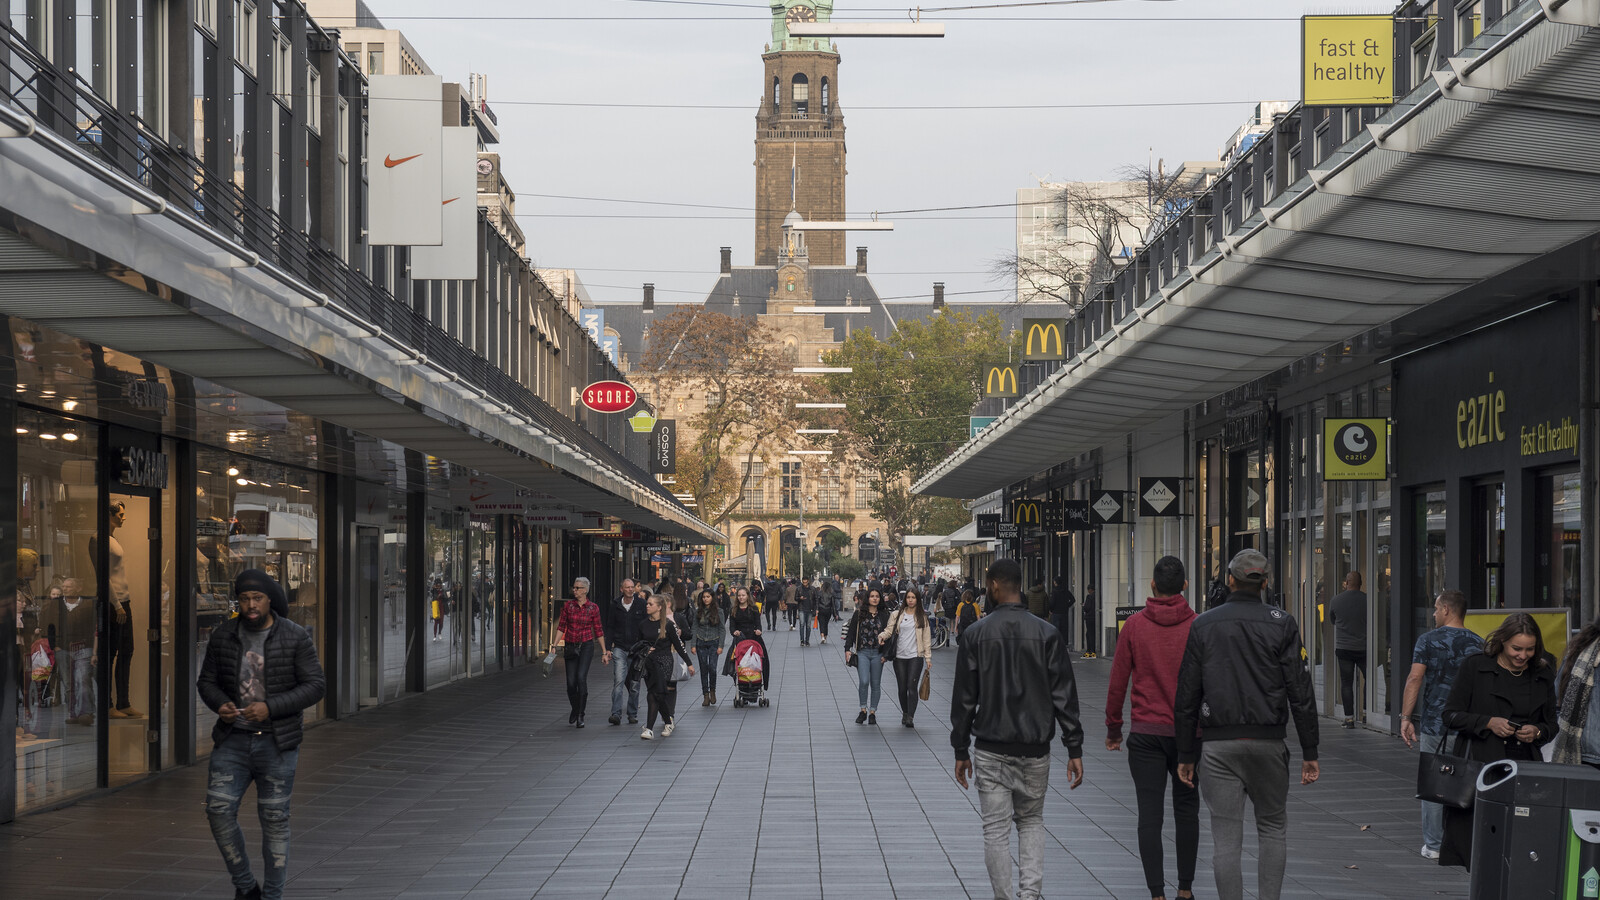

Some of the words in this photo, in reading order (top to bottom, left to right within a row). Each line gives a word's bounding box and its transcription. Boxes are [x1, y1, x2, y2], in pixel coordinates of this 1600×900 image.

[1319, 38, 1356, 56] fast
[1363, 38, 1379, 56] &
[1314, 62, 1386, 84] healthy
[588, 390, 631, 404] SCORE
[1456, 371, 1506, 448] eazie
[1520, 425, 1537, 456] fast
[1538, 424, 1546, 454] &
[1546, 416, 1579, 456] healthy
